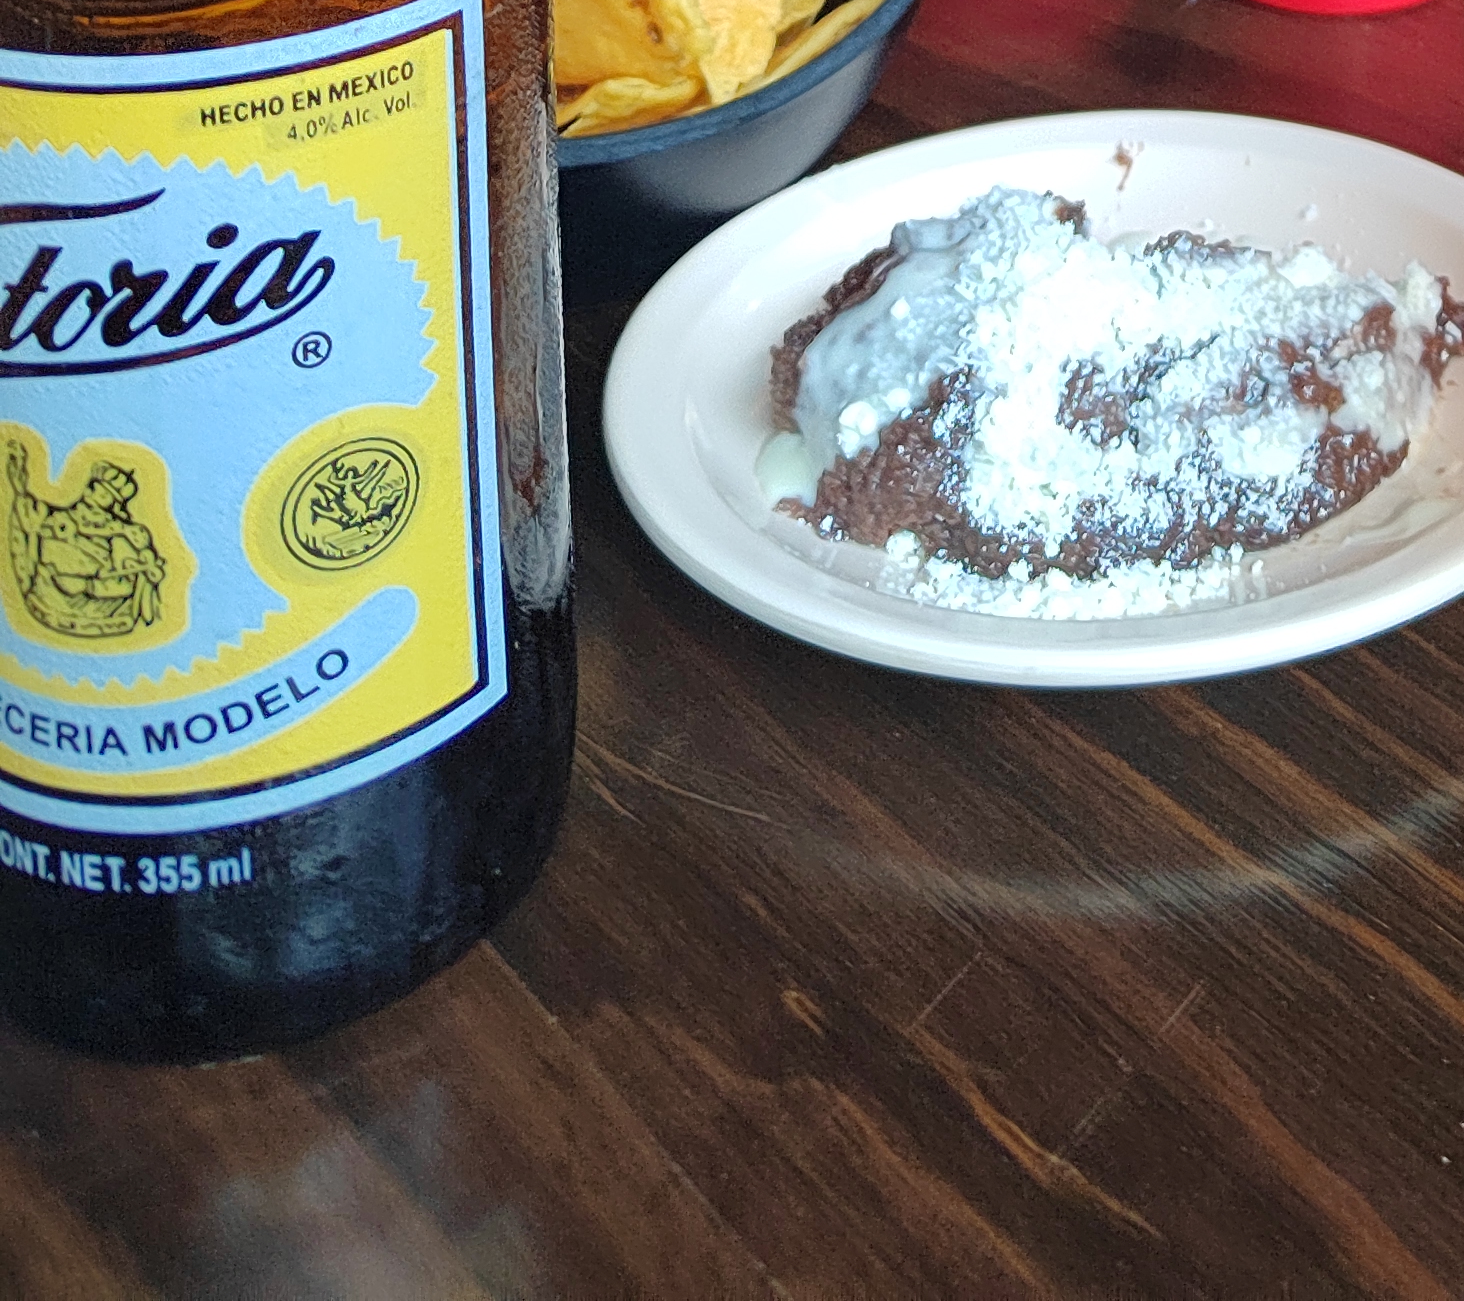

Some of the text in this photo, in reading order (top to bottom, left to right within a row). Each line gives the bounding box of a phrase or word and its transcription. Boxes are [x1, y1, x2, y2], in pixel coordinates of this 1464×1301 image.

[200, 59, 415, 127] HECHO EN MEXICO
[0, 648, 350, 756] CERIA MODELO
[60, 849, 133, 894] NET.
[136, 853, 202, 894] 355
[207, 845, 253, 888] ml
